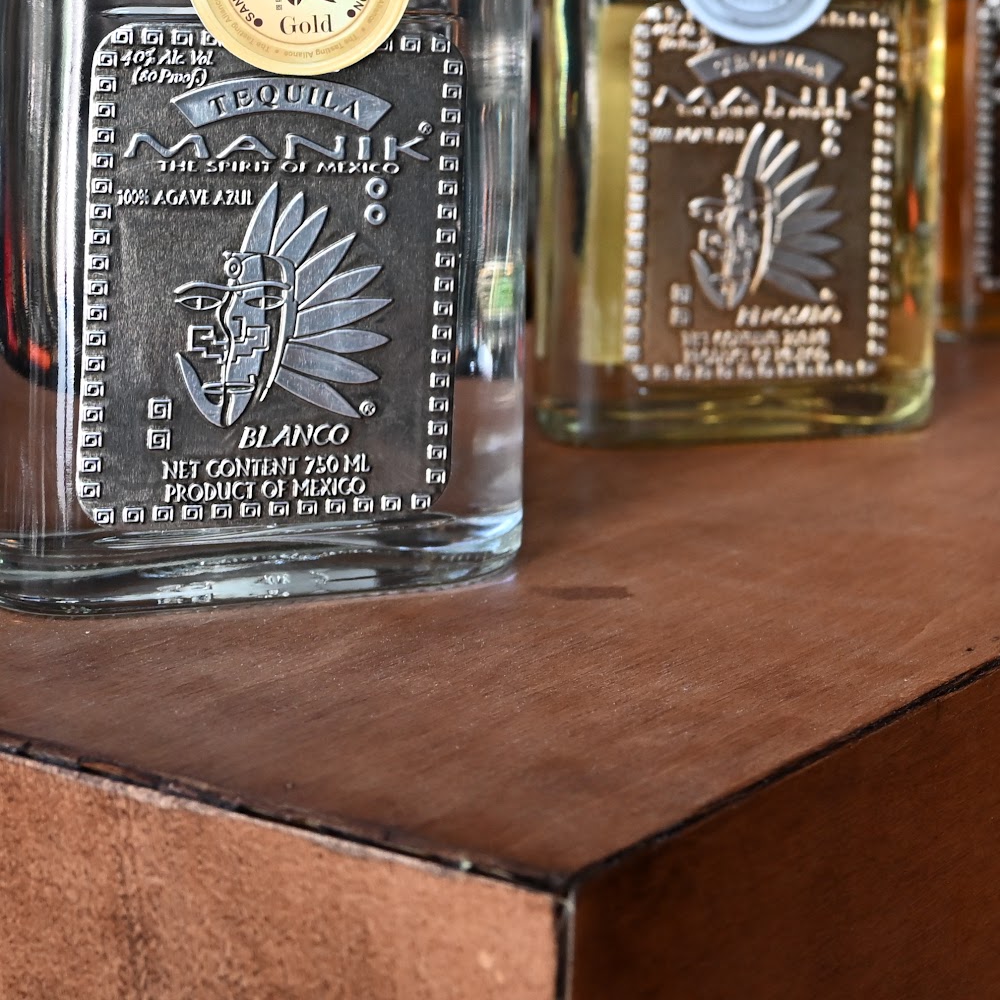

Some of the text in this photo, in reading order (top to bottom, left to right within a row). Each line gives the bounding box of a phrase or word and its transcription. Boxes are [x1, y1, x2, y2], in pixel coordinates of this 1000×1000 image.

[280, 13, 333, 35] Gold
[120, 47, 156, 67] 40%
[131, 66, 158, 85] (80
[208, 84, 360, 120] TEQUILA
[158, 160, 198, 172] THE
[206, 161, 271, 172] SPIRIT
[316, 161, 400, 174] MEXICO
[117, 189, 254, 206] 100% AGAVE AZUL
[238, 424, 350, 449] BLANCO
[162, 453, 370, 479] NET CONTENT 750 ML
[164, 476, 366, 503] PRODUCT OF MEXICO
